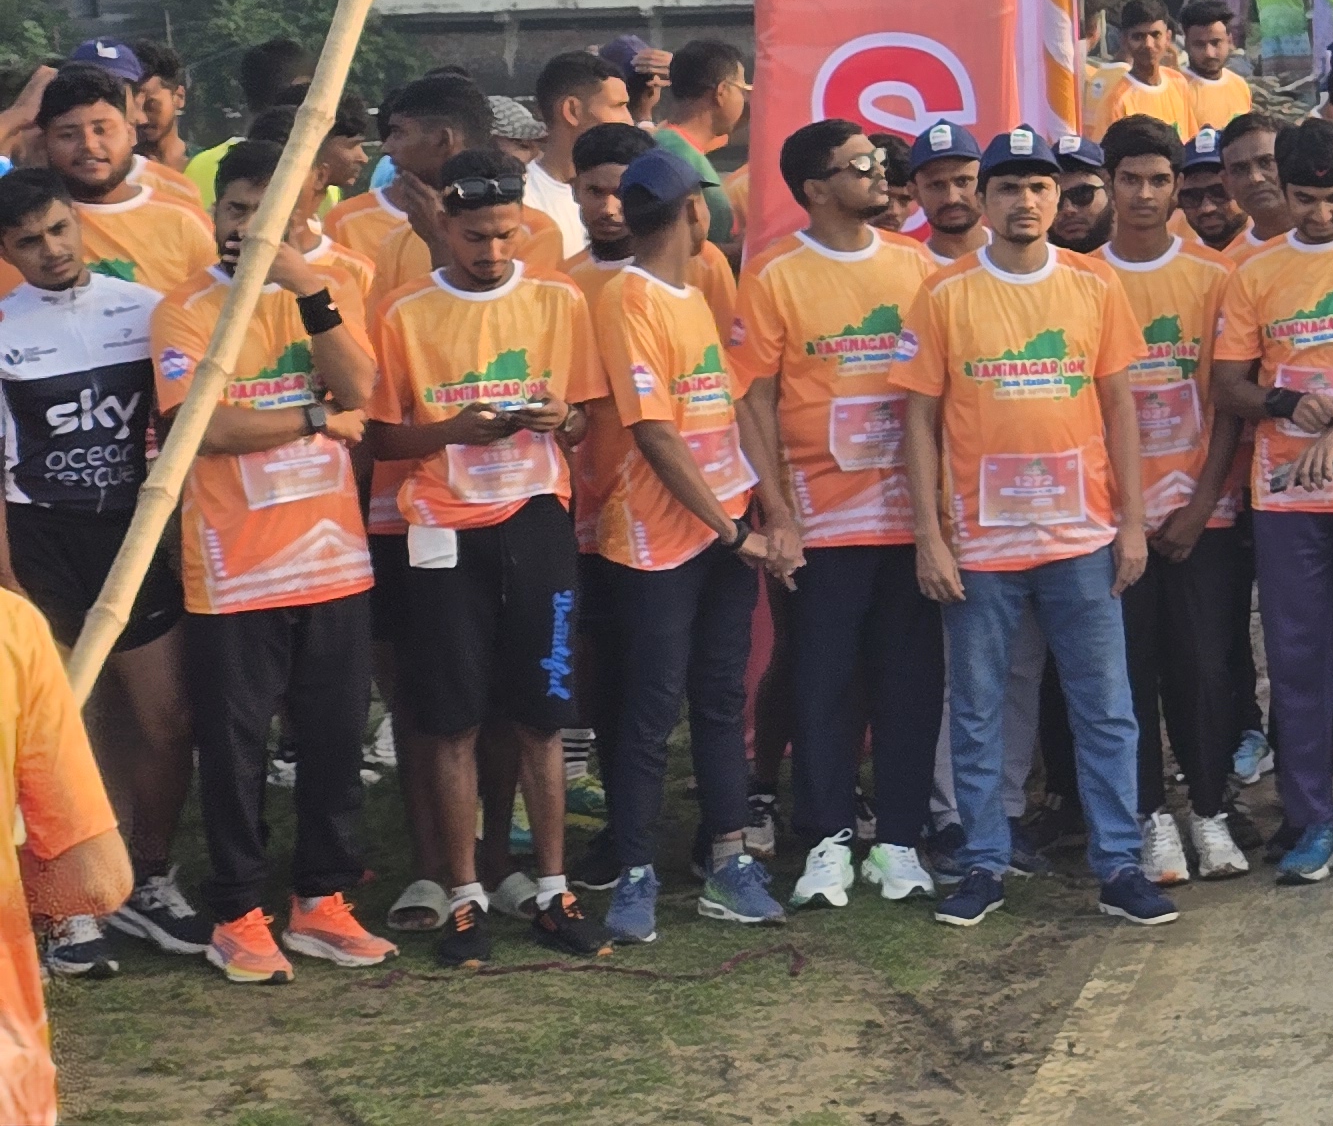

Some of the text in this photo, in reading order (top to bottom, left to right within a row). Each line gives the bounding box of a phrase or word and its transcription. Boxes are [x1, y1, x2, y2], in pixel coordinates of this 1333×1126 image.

[973, 360, 1085, 377] RANINAGAR 10K
[46, 388, 142, 440] sky
